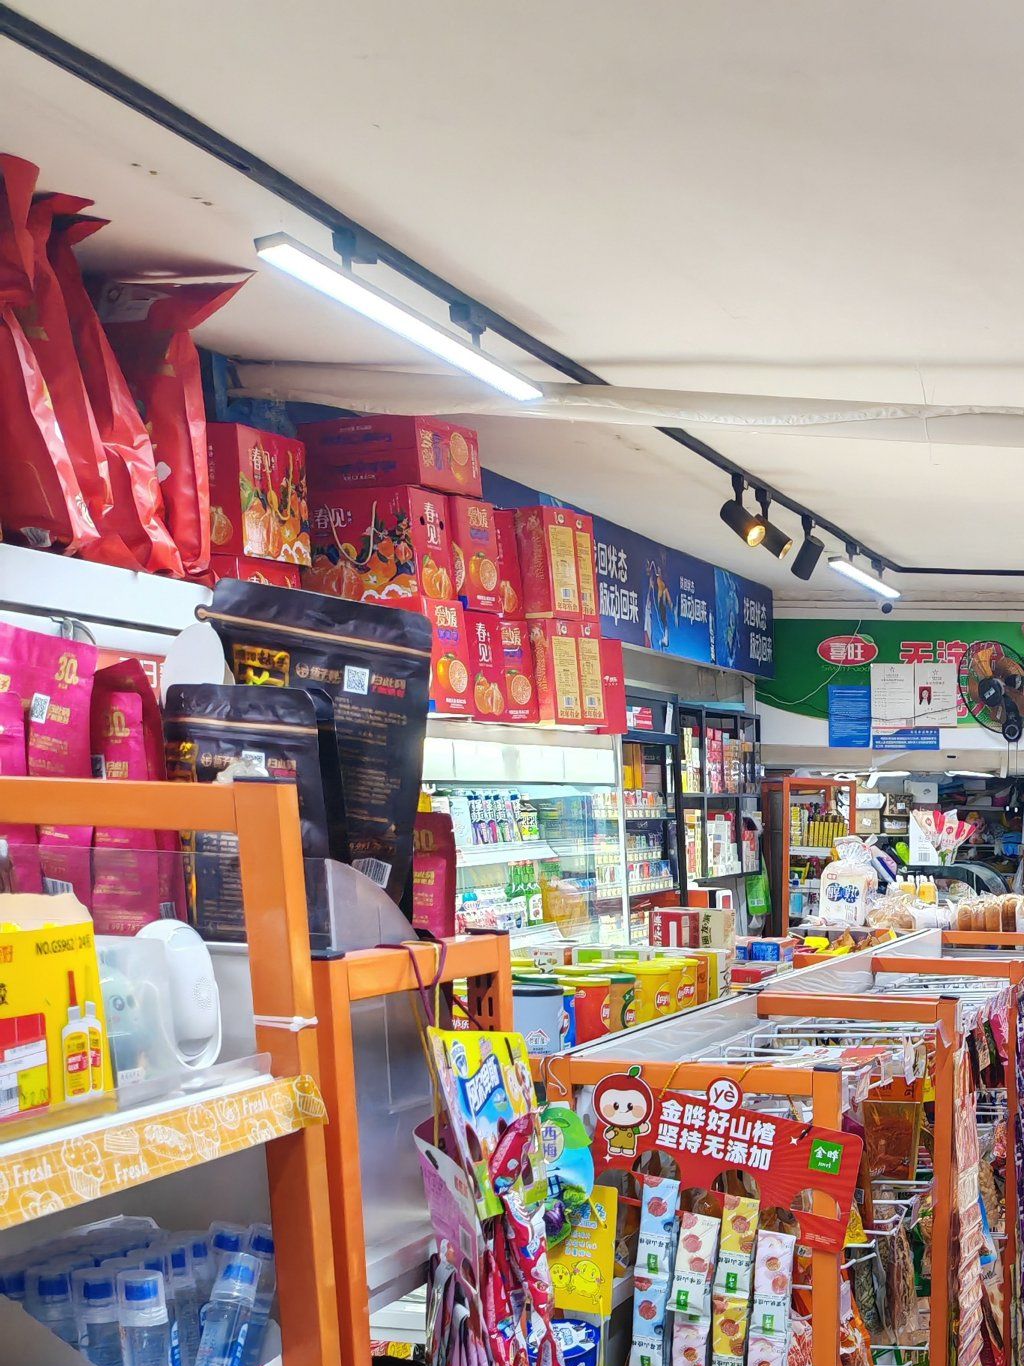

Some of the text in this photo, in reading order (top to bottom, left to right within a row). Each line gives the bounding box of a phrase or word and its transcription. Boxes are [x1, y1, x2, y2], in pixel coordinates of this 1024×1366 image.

[595, 540, 628, 582] 回状态
[680, 594, 708, 624] 脉动回来
[242, 1095, 270, 1117] Fresh
[660, 1100, 776, 1147] 金晔好山楂
[655, 1124, 773, 1172] 坚持无添加
[813, 1145, 839, 1163] 金晔
[13, 1155, 150, 1187] Fresh Fresh
